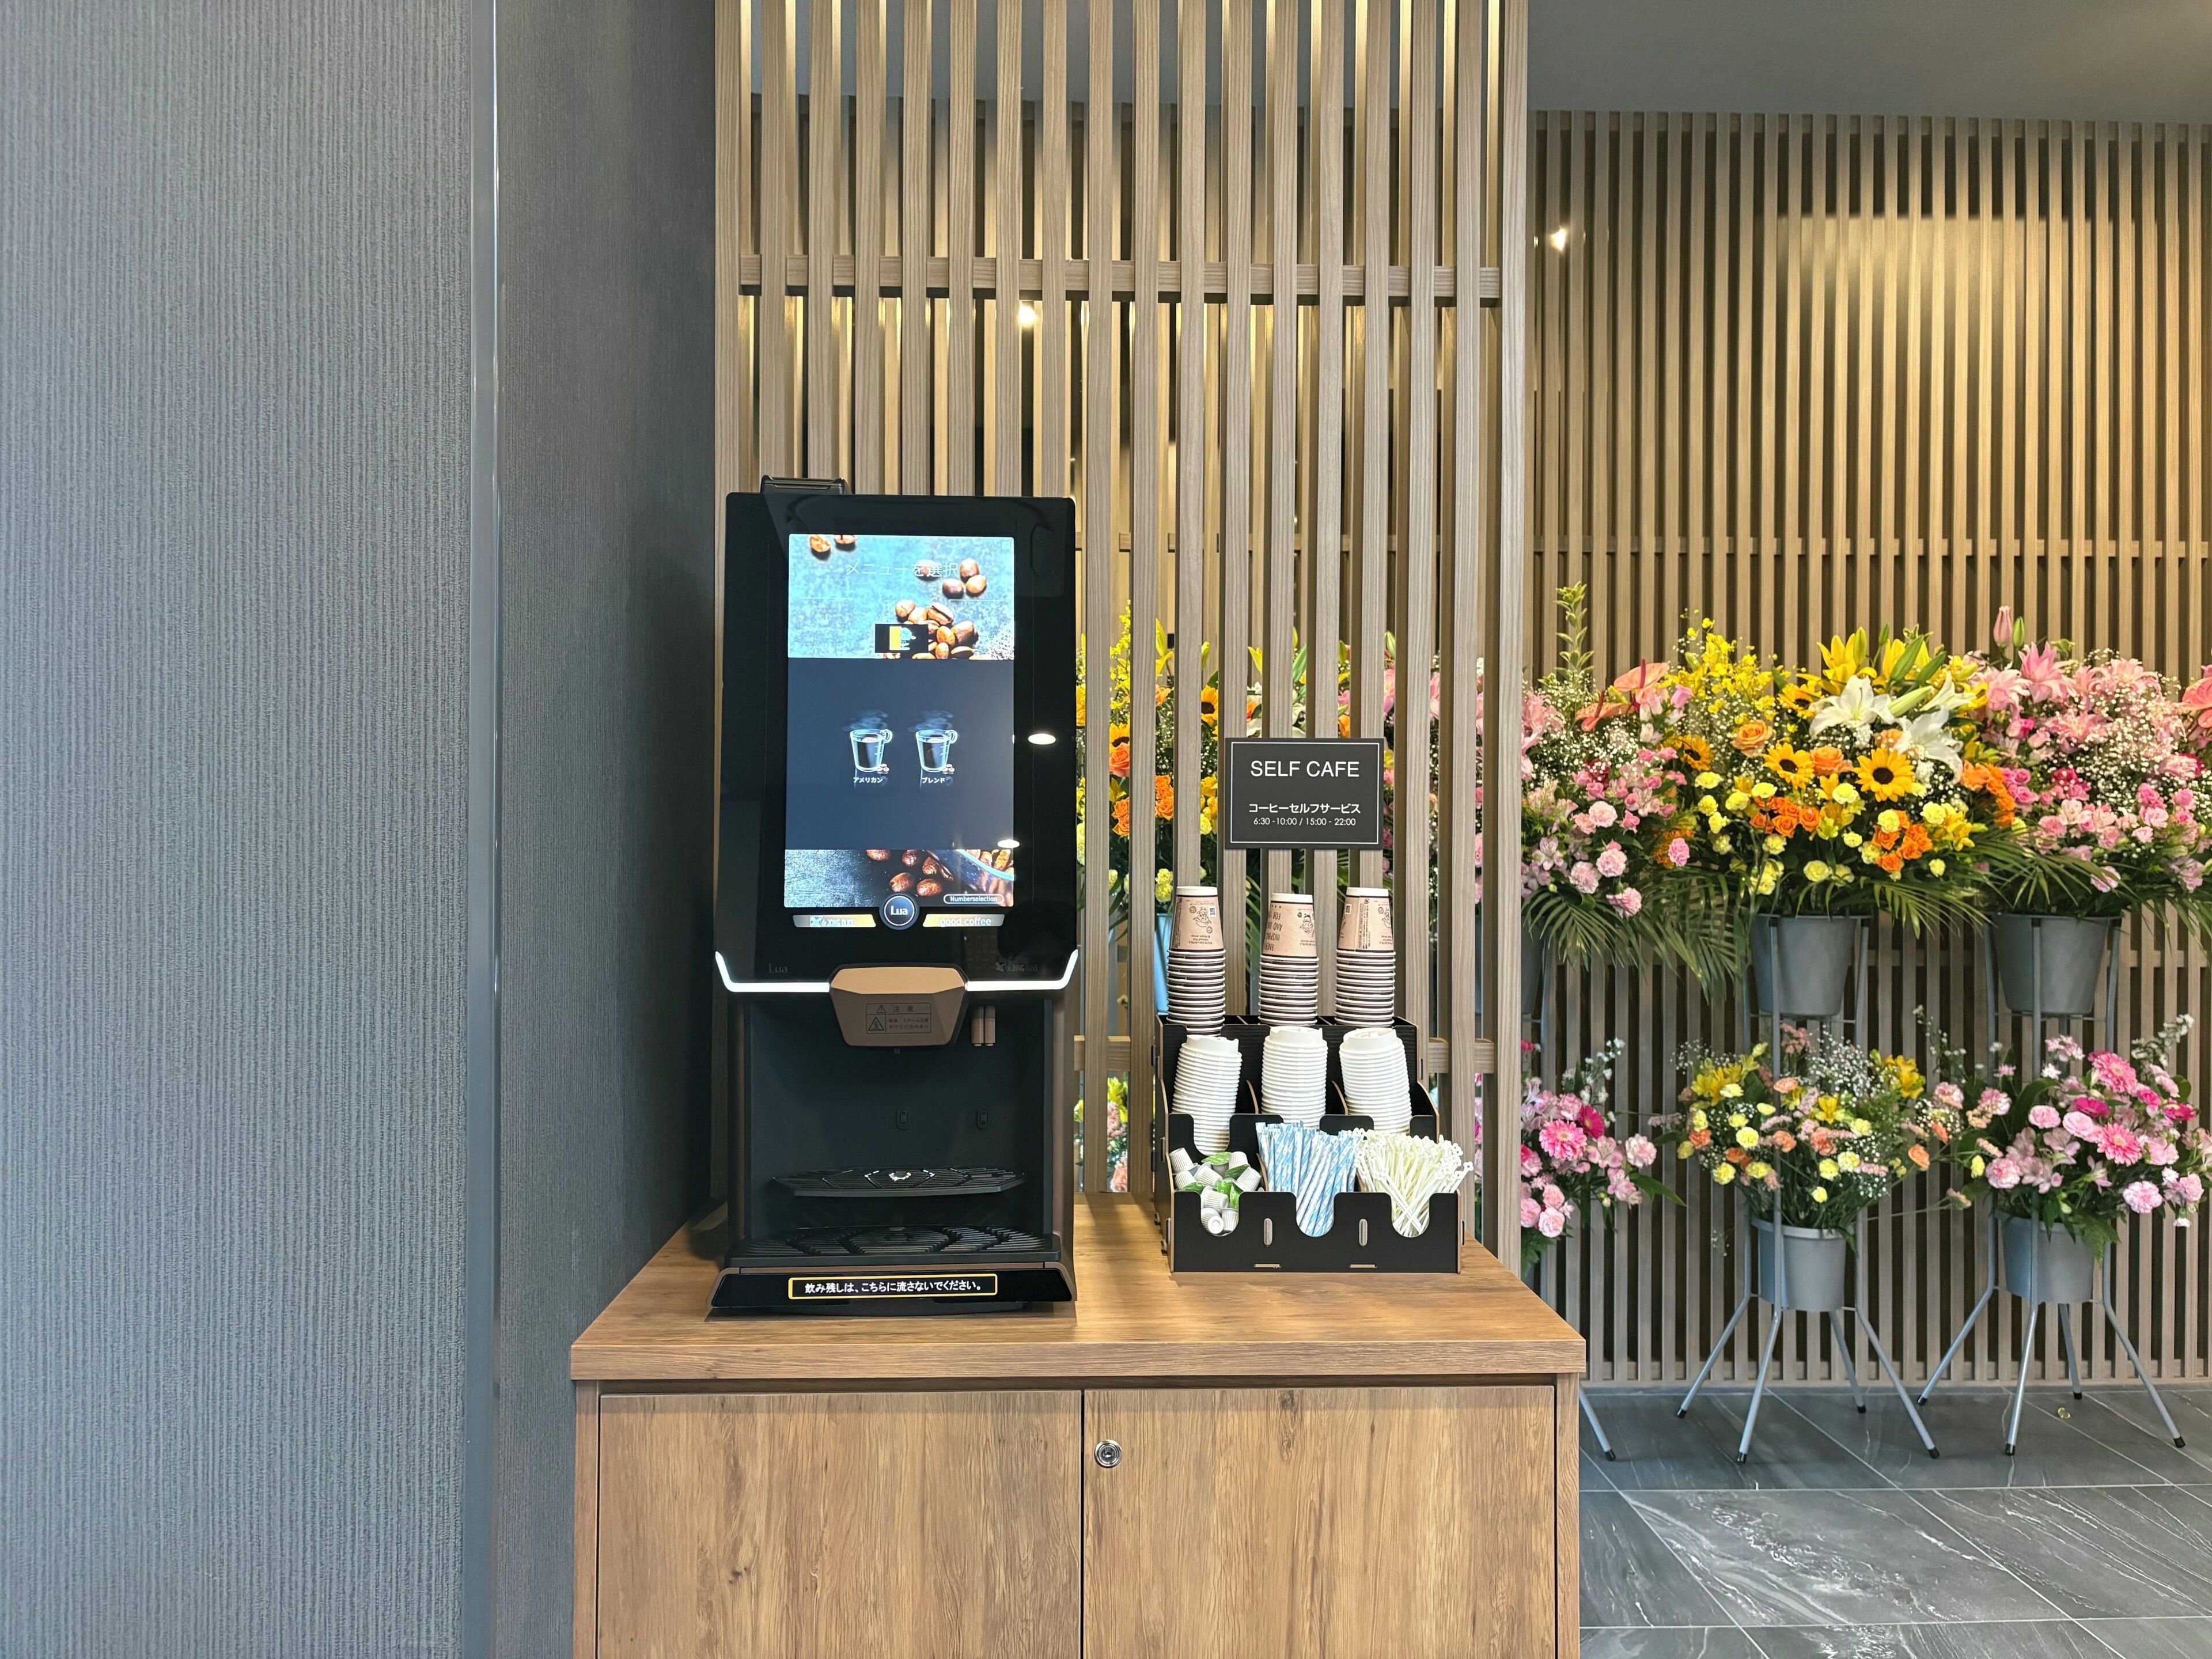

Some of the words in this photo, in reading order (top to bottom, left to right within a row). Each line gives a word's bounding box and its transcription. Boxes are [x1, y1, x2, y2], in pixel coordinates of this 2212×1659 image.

[846, 561, 960, 578] メニューを選択
[1251, 760, 1301, 777] SELF
[1306, 760, 1359, 777] CAFE
[1249, 803, 1361, 813] コーヒーセルフサービス
[891, 906, 908, 915] Lua
[940, 917, 961, 927] good
[964, 917, 992, 926] coffee
[769, 964, 787, 973] Lua
[805, 1280, 982, 1294] 飲み残しは、こちらに流さないでください。
